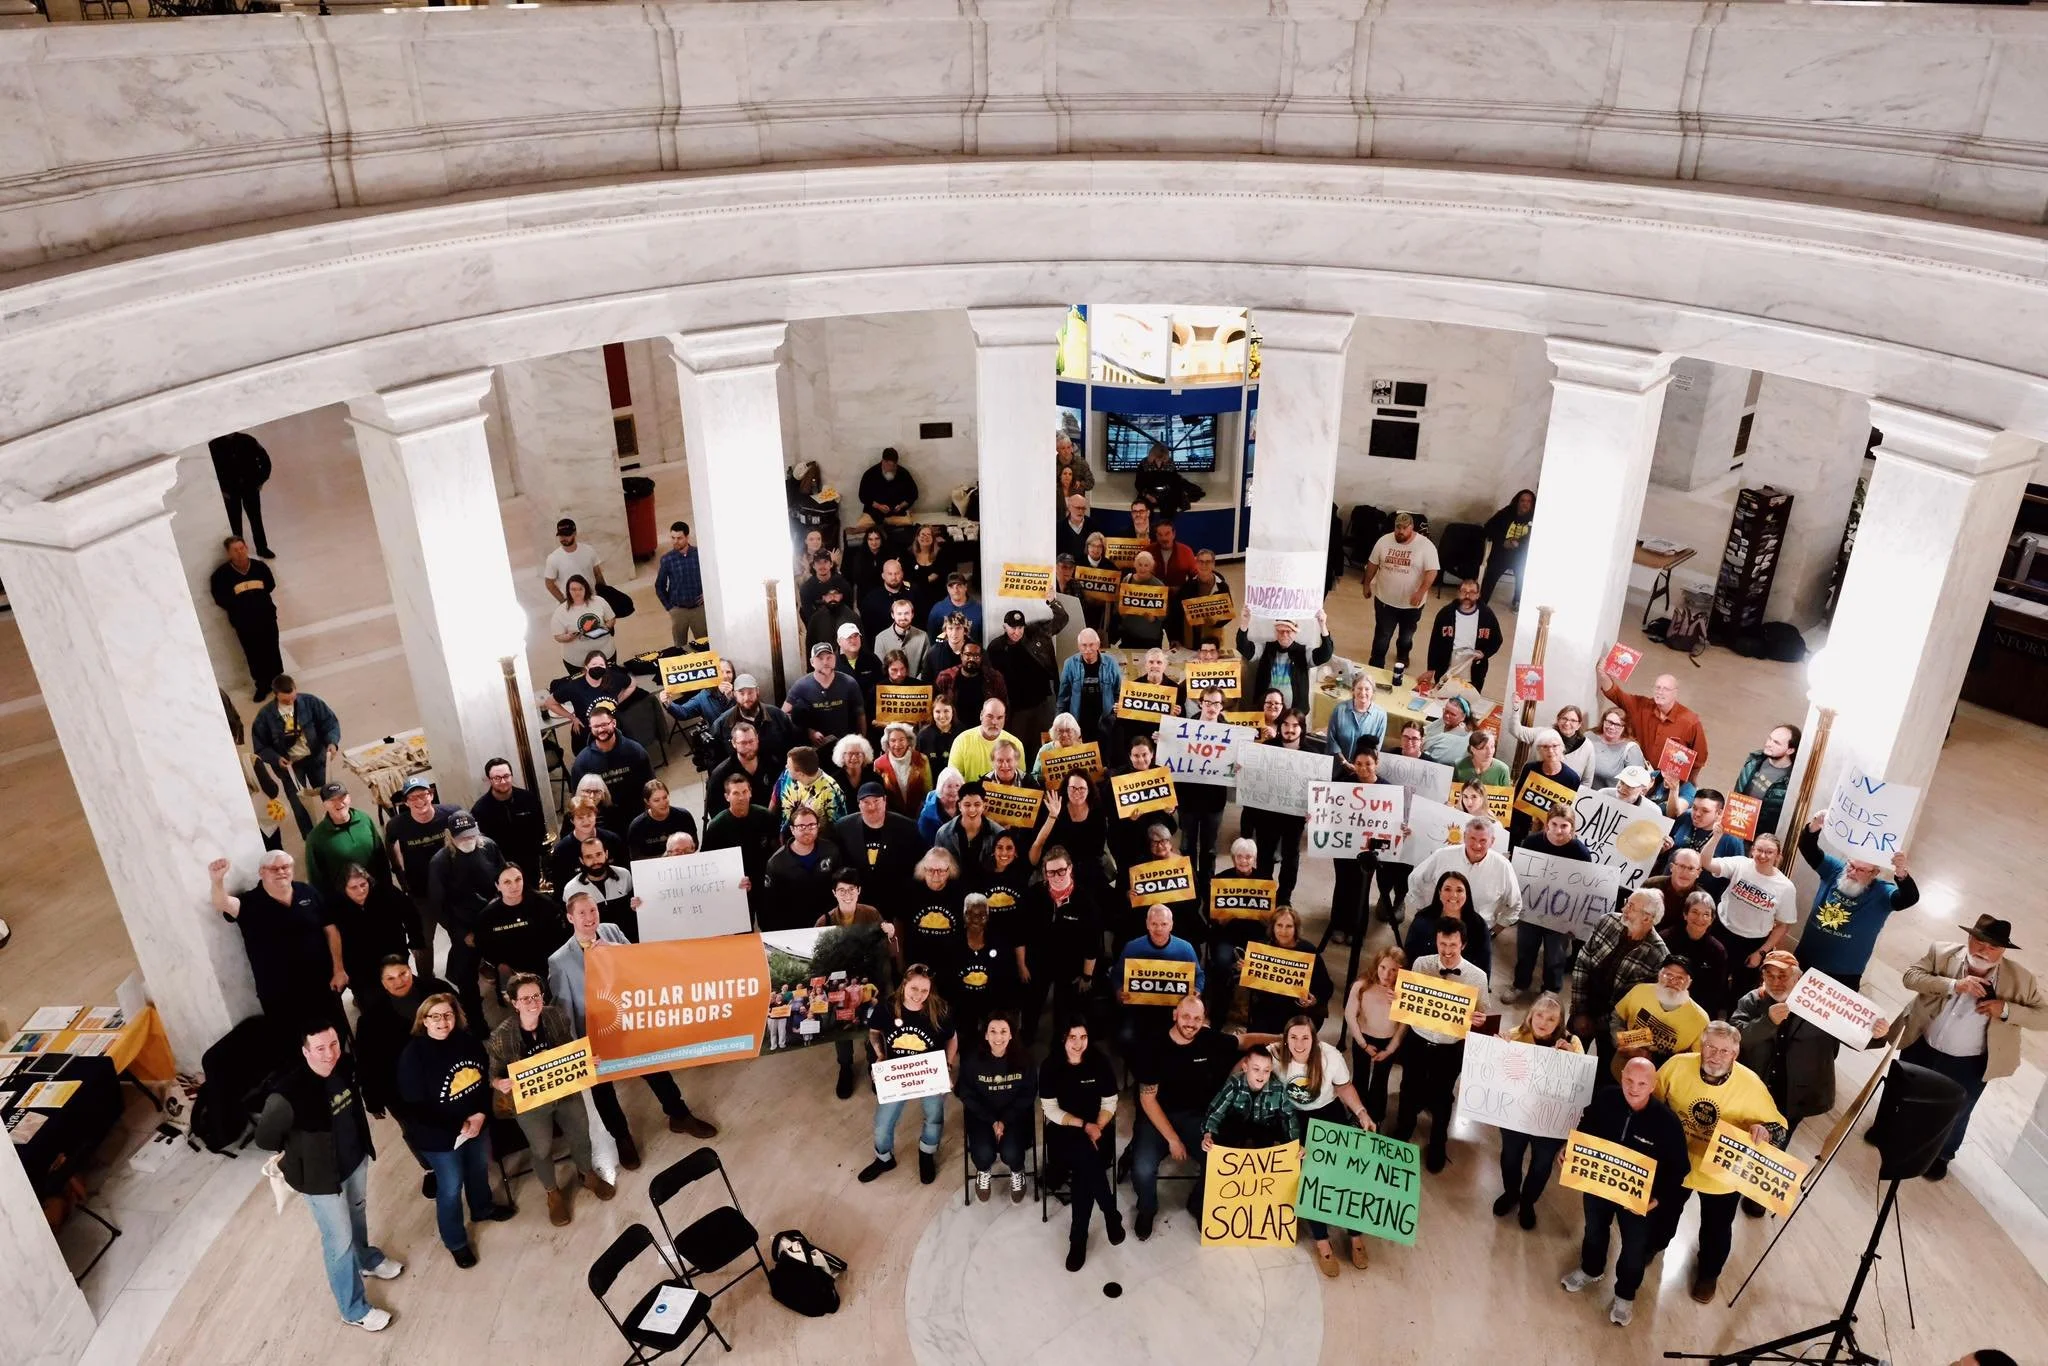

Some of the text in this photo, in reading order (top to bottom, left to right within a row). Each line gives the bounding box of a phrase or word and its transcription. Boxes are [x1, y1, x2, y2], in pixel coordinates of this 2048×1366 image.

[1387, 548, 1412, 558] FIGHT
[1080, 581, 1115, 592] SOLAR
[1083, 574, 1116, 582] SUPPORT
[1123, 598, 1163, 608] SOLAR
[668, 668, 716, 684] SOLAR
[671, 660, 714, 672] SUPPORT
[1191, 679, 1236, 688] SOLAR
[1124, 698, 1170, 713] SOLAR
[1131, 691, 1171, 701] SUPPORT
[1177, 722, 1231, 744] 1 for 1
[1062, 751, 1095, 762] VIRGINIANS
[1188, 742, 1226, 758] NOT
[1048, 760, 1097, 773] FOR SOLAR
[1165, 756, 1236, 778] ALL for 1
[1124, 777, 1165, 791] SUPPORT
[1003, 795, 1036, 804] VIRGINIANS
[1120, 787, 1169, 805] SOLAR
[1312, 786, 1345, 806] The
[1349, 787, 1393, 813] Sun
[1535, 784, 1572, 806] SUPPOR
[1007, 802, 1034, 811] SOLAR
[1349, 812, 1388, 830] there
[1575, 796, 1628, 845] SAVE
[1829, 808, 1897, 852] SOLAR
[1313, 830, 1353, 849] USE
[658, 862, 719, 881] UTILITIES
[1139, 867, 1185, 880] SUPPORT
[690, 880, 726, 894] PROFIT
[1134, 877, 1188, 894] SOLAR
[1222, 888, 1270, 896] SUPPORT
[1737, 879, 1775, 902] ENERGY
[1216, 897, 1269, 909] SOLAR
[1732, 885, 1774, 908] FREEDOM
[672, 906, 682, 914] AT
[1250, 961, 1306, 978] FOR SOLAR
[1251, 953, 1309, 969] WEST VIRGINIANS
[1137, 970, 1188, 980] SUPPORT
[1247, 969, 1304, 987] FREEDOM
[621, 977, 759, 1009] SOLAR UNITED
[1131, 980, 1187, 993] SOLAR
[1402, 983, 1469, 1004] WEST VIRGINIANS
[1401, 992, 1467, 1015] FOR SOLAR
[1795, 995, 1830, 1020] SOLAR
[1801, 986, 1871, 1029] COMMUNITY
[1808, 976, 1876, 1019] WE SUPPORT
[622, 1003, 733, 1031] NEIGHBORS
[1399, 1002, 1464, 1025] FREEDOM
[517, 1050, 585, 1080] WEST VIRGINIANS
[891, 1059, 928, 1072] Support
[1533, 1047, 1596, 1081] WANT
[520, 1060, 587, 1090] FOR SOLAR
[521, 1069, 588, 1099] FREEDOM
[884, 1067, 938, 1082] Community
[901, 1079, 925, 1088] Solar
[1466, 1062, 1585, 1103] TO KEEP
[450, 1092, 463, 1101] FOR
[1465, 1085, 1513, 1119] OUR
[1311, 1125, 1415, 1164] DON'T TREAD
[1217, 1149, 1293, 1176] SAVE
[1574, 1145, 1648, 1178] WEST VIRGINIANS
[1720, 1135, 1796, 1180] WEST VIRGINIANS
[1312, 1149, 1416, 1192] ON MY NET
[1572, 1156, 1645, 1188] FOR SOLAR
[1713, 1155, 1786, 1201] FREEDOM
[1717, 1145, 1789, 1191] FOR SOLAR
[1220, 1177, 1275, 1198] OUR
[1571, 1165, 1642, 1199] FREEDOM
[1300, 1176, 1416, 1235] METERING
[1205, 1203, 1296, 1243] SOLAR
